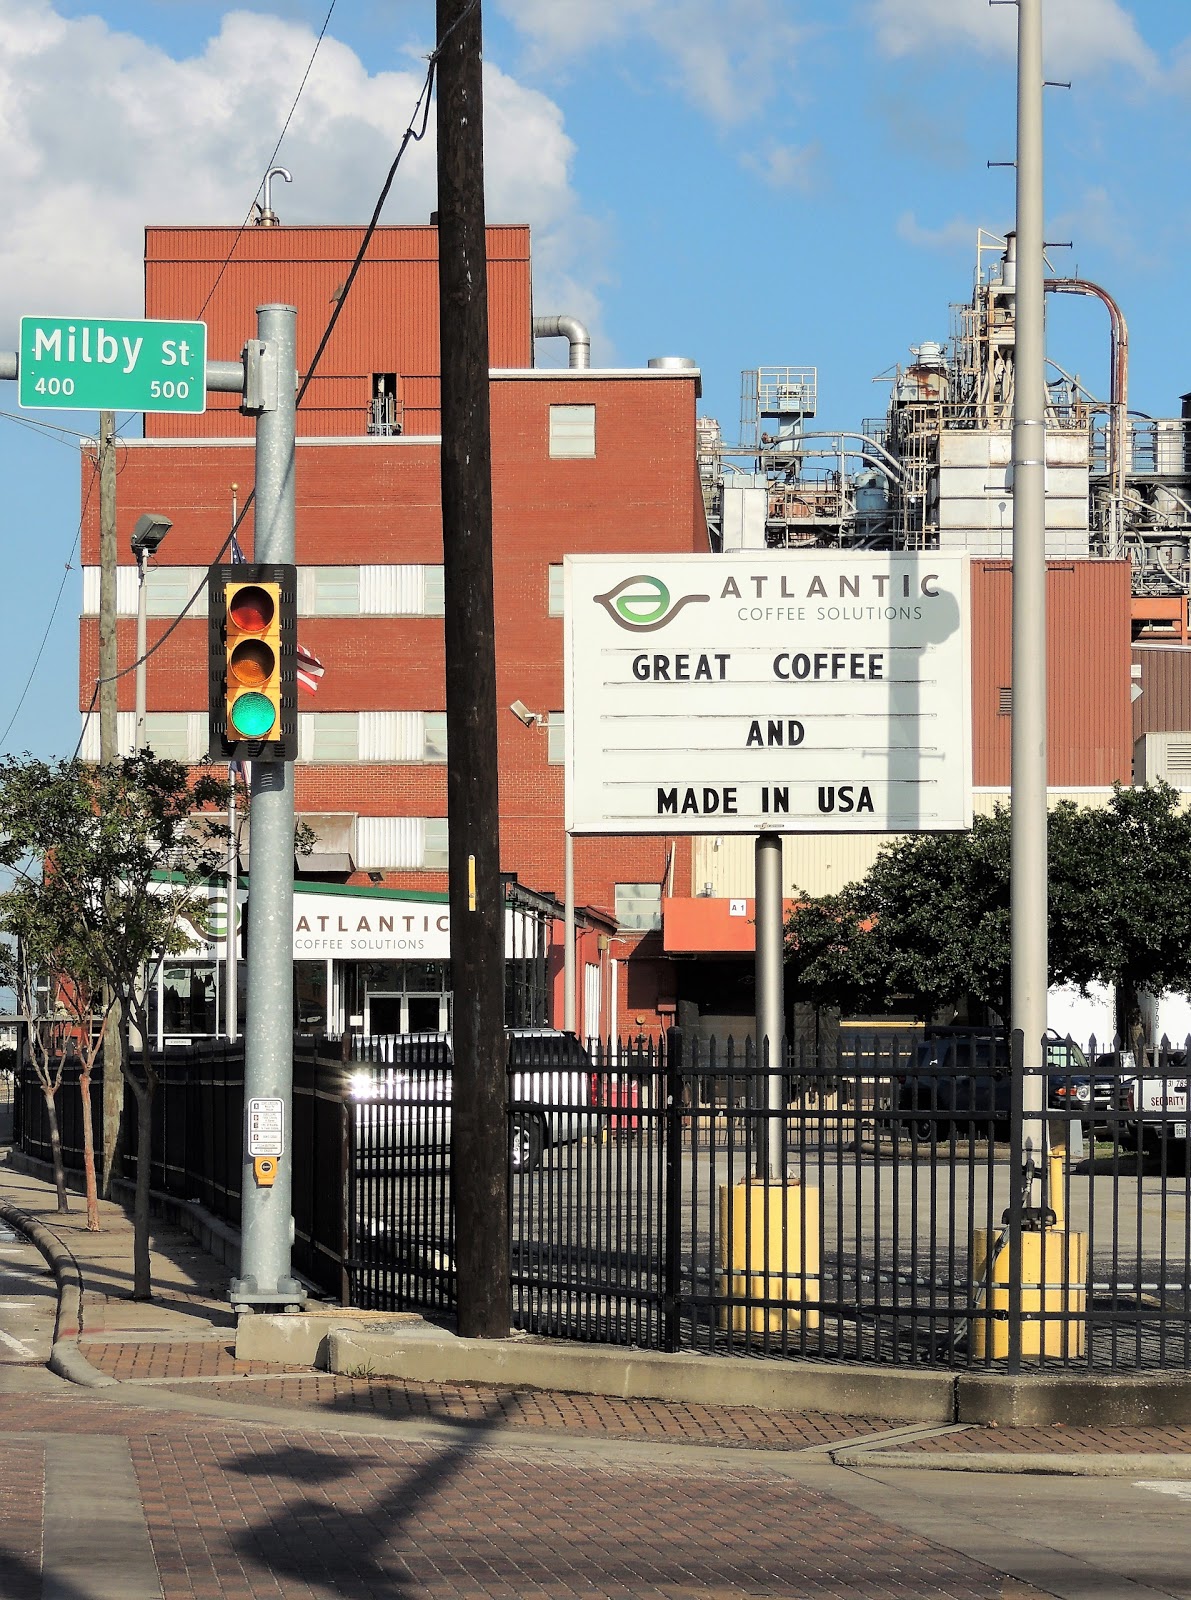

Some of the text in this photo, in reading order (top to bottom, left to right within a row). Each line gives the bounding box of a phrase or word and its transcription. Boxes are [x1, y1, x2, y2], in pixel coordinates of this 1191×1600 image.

[35, 326, 190, 374] Milby St
[34, 377, 75, 395] 400
[150, 380, 189, 399] 500
[720, 574, 940, 598] ATLANTIC
[737, 606, 922, 621] COFFEE SOLUTIONS
[632, 652, 884, 680] GREAT COFFEE
[746, 719, 805, 747] AND
[657, 786, 875, 814] MADE IN USA
[295, 915, 449, 932] ATLANTIC
[295, 939, 425, 949] COFFEE SOLUTIONS
